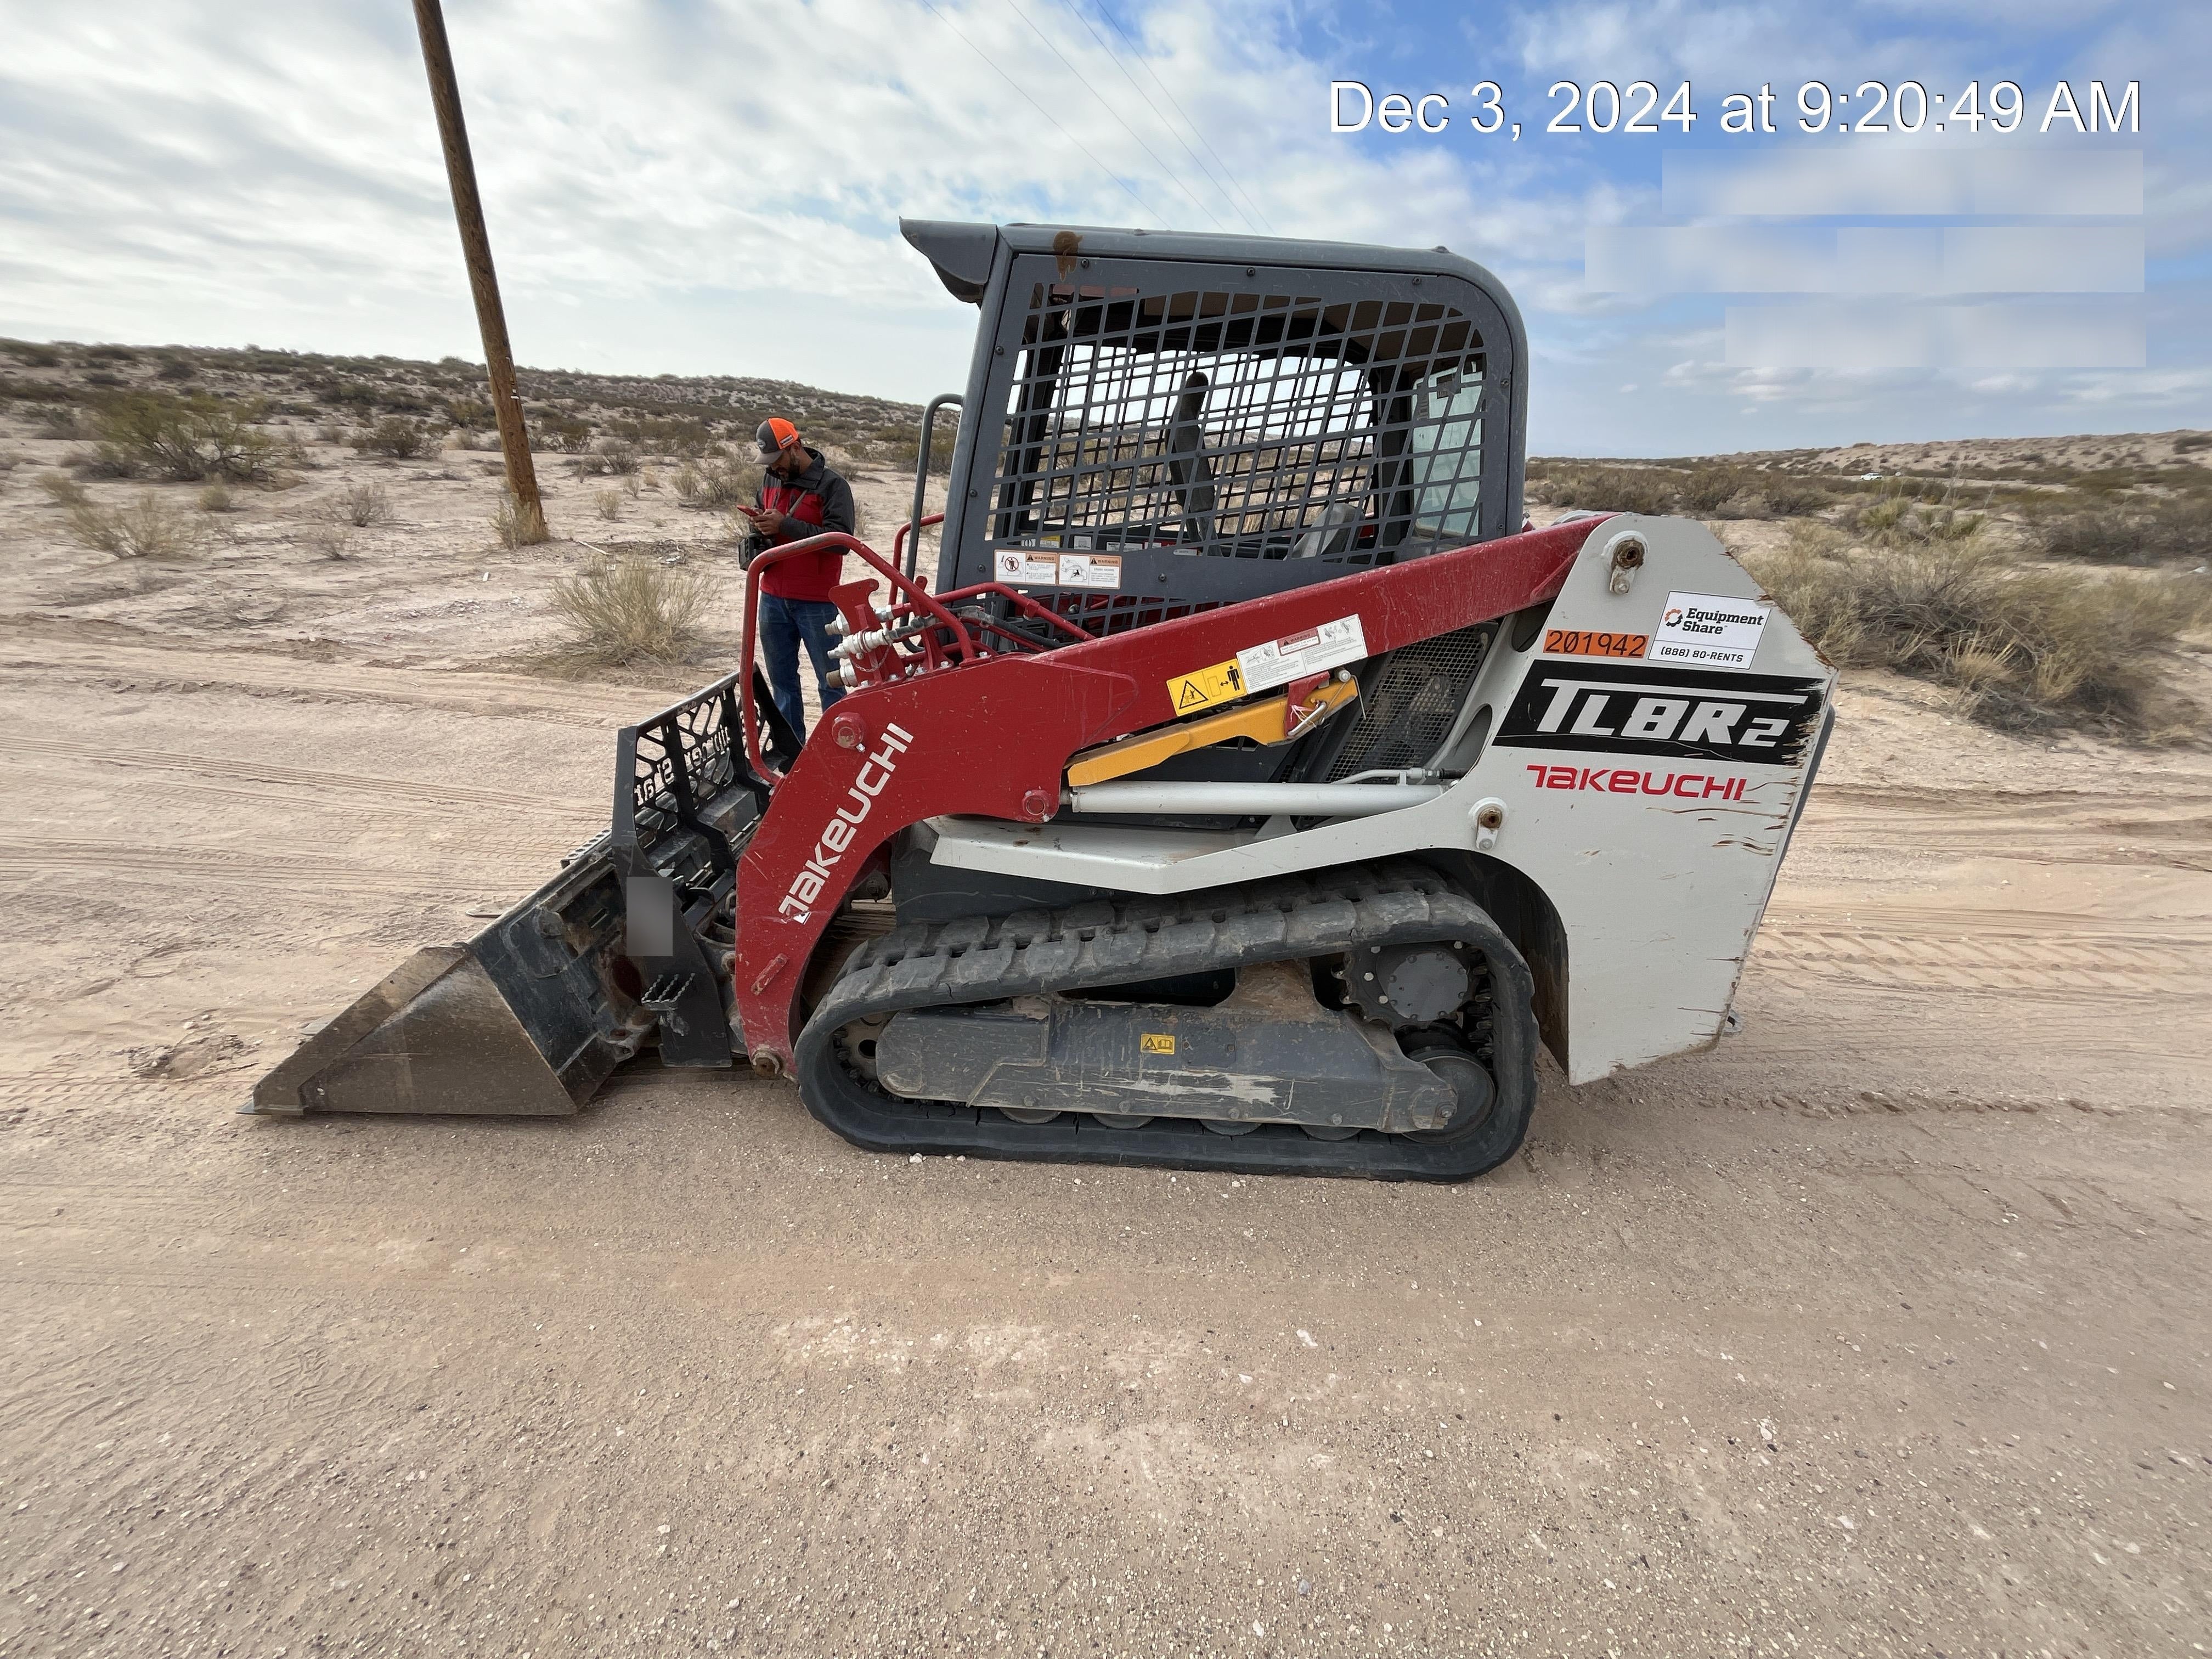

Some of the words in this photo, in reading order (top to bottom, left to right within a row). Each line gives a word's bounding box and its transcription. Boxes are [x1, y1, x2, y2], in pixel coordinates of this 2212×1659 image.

[1686, 607, 1764, 625] Equipment
[1682, 620, 1724, 634] Share
[1289, 633, 1311, 643] WARNING
[1545, 630, 1646, 657] 201942
[1661, 646, 1690, 658] (888)
[1692, 650, 1743, 662] 80-RENTS
[1537, 678, 1809, 747] TL8R2
